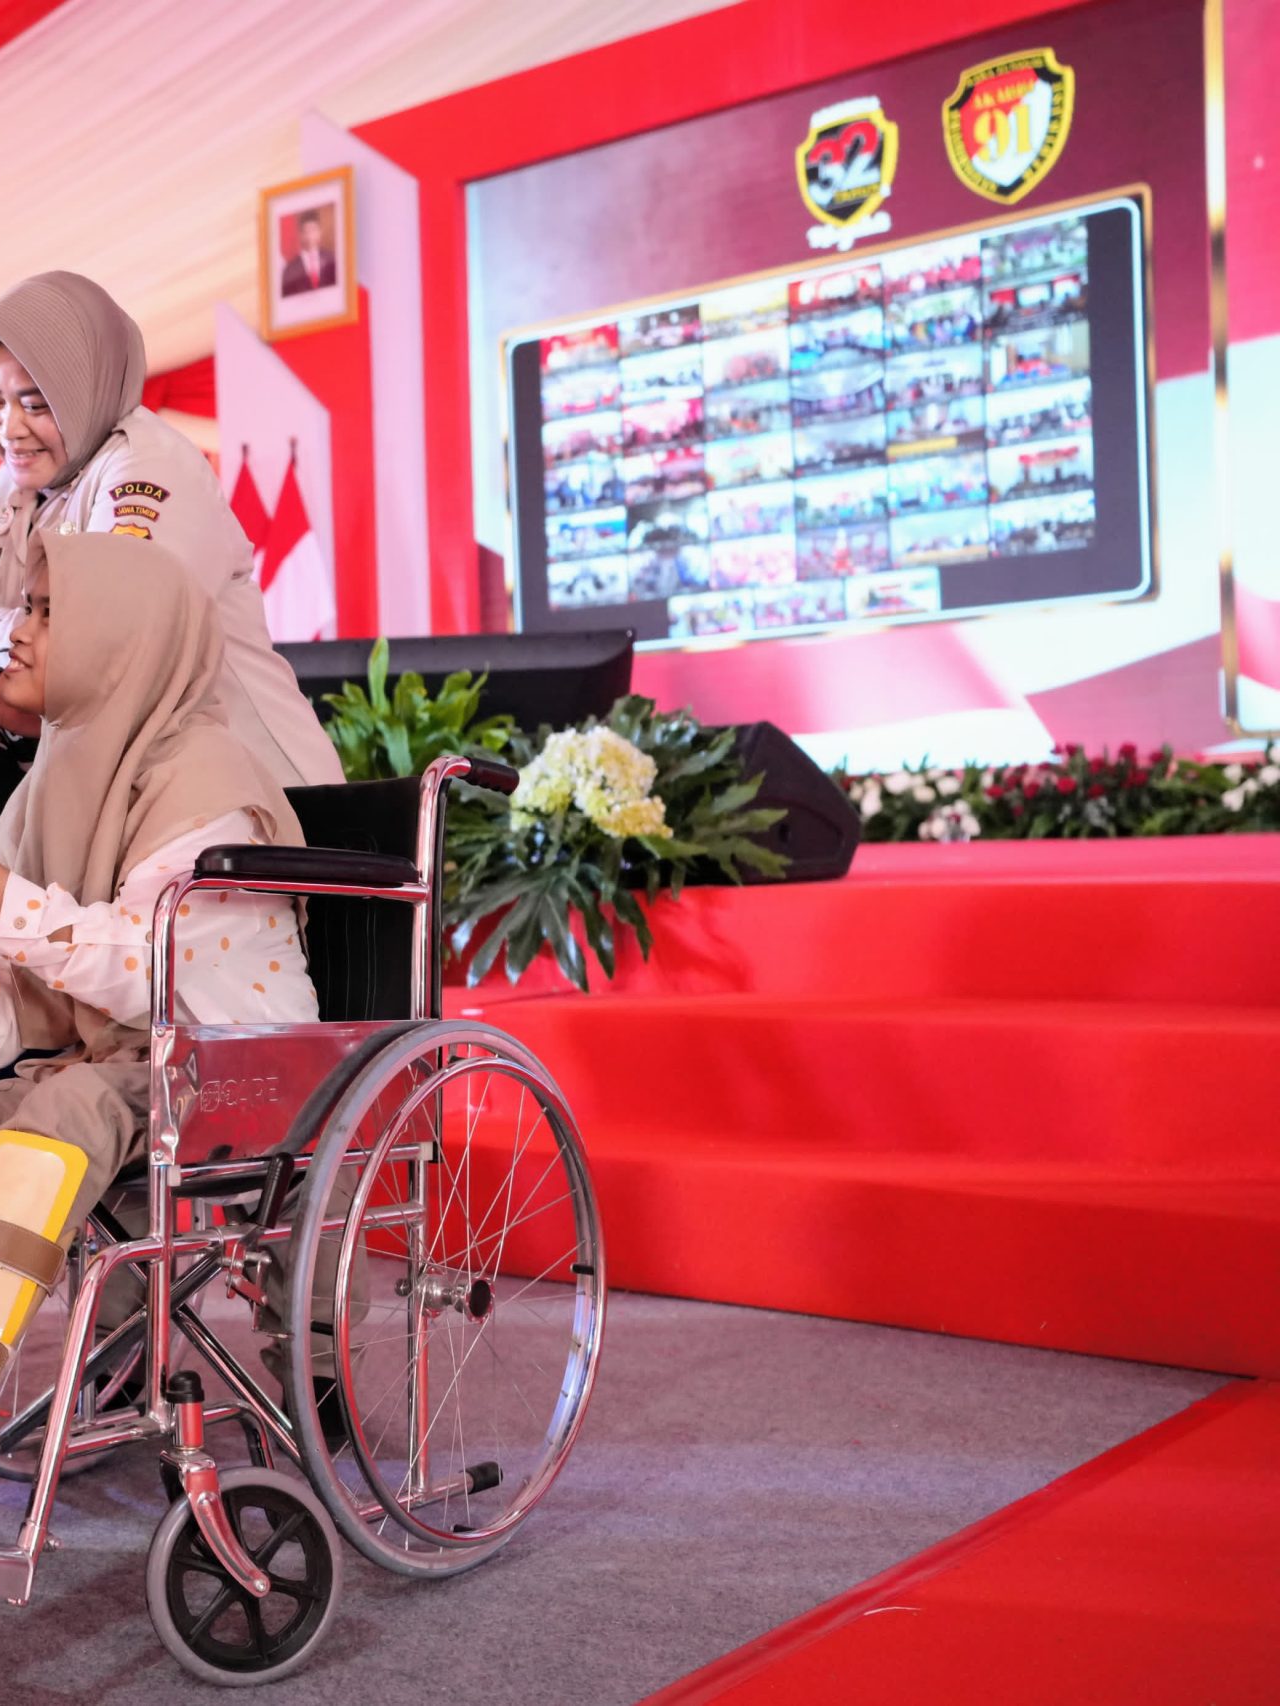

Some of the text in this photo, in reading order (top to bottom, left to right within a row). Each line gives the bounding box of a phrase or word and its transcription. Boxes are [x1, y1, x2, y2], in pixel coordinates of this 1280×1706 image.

[974, 104, 1032, 162] 91
[808, 121, 881, 209] 32
[115, 484, 162, 500] POLDA
[116, 506, 157, 519] JAWA TIMUR
